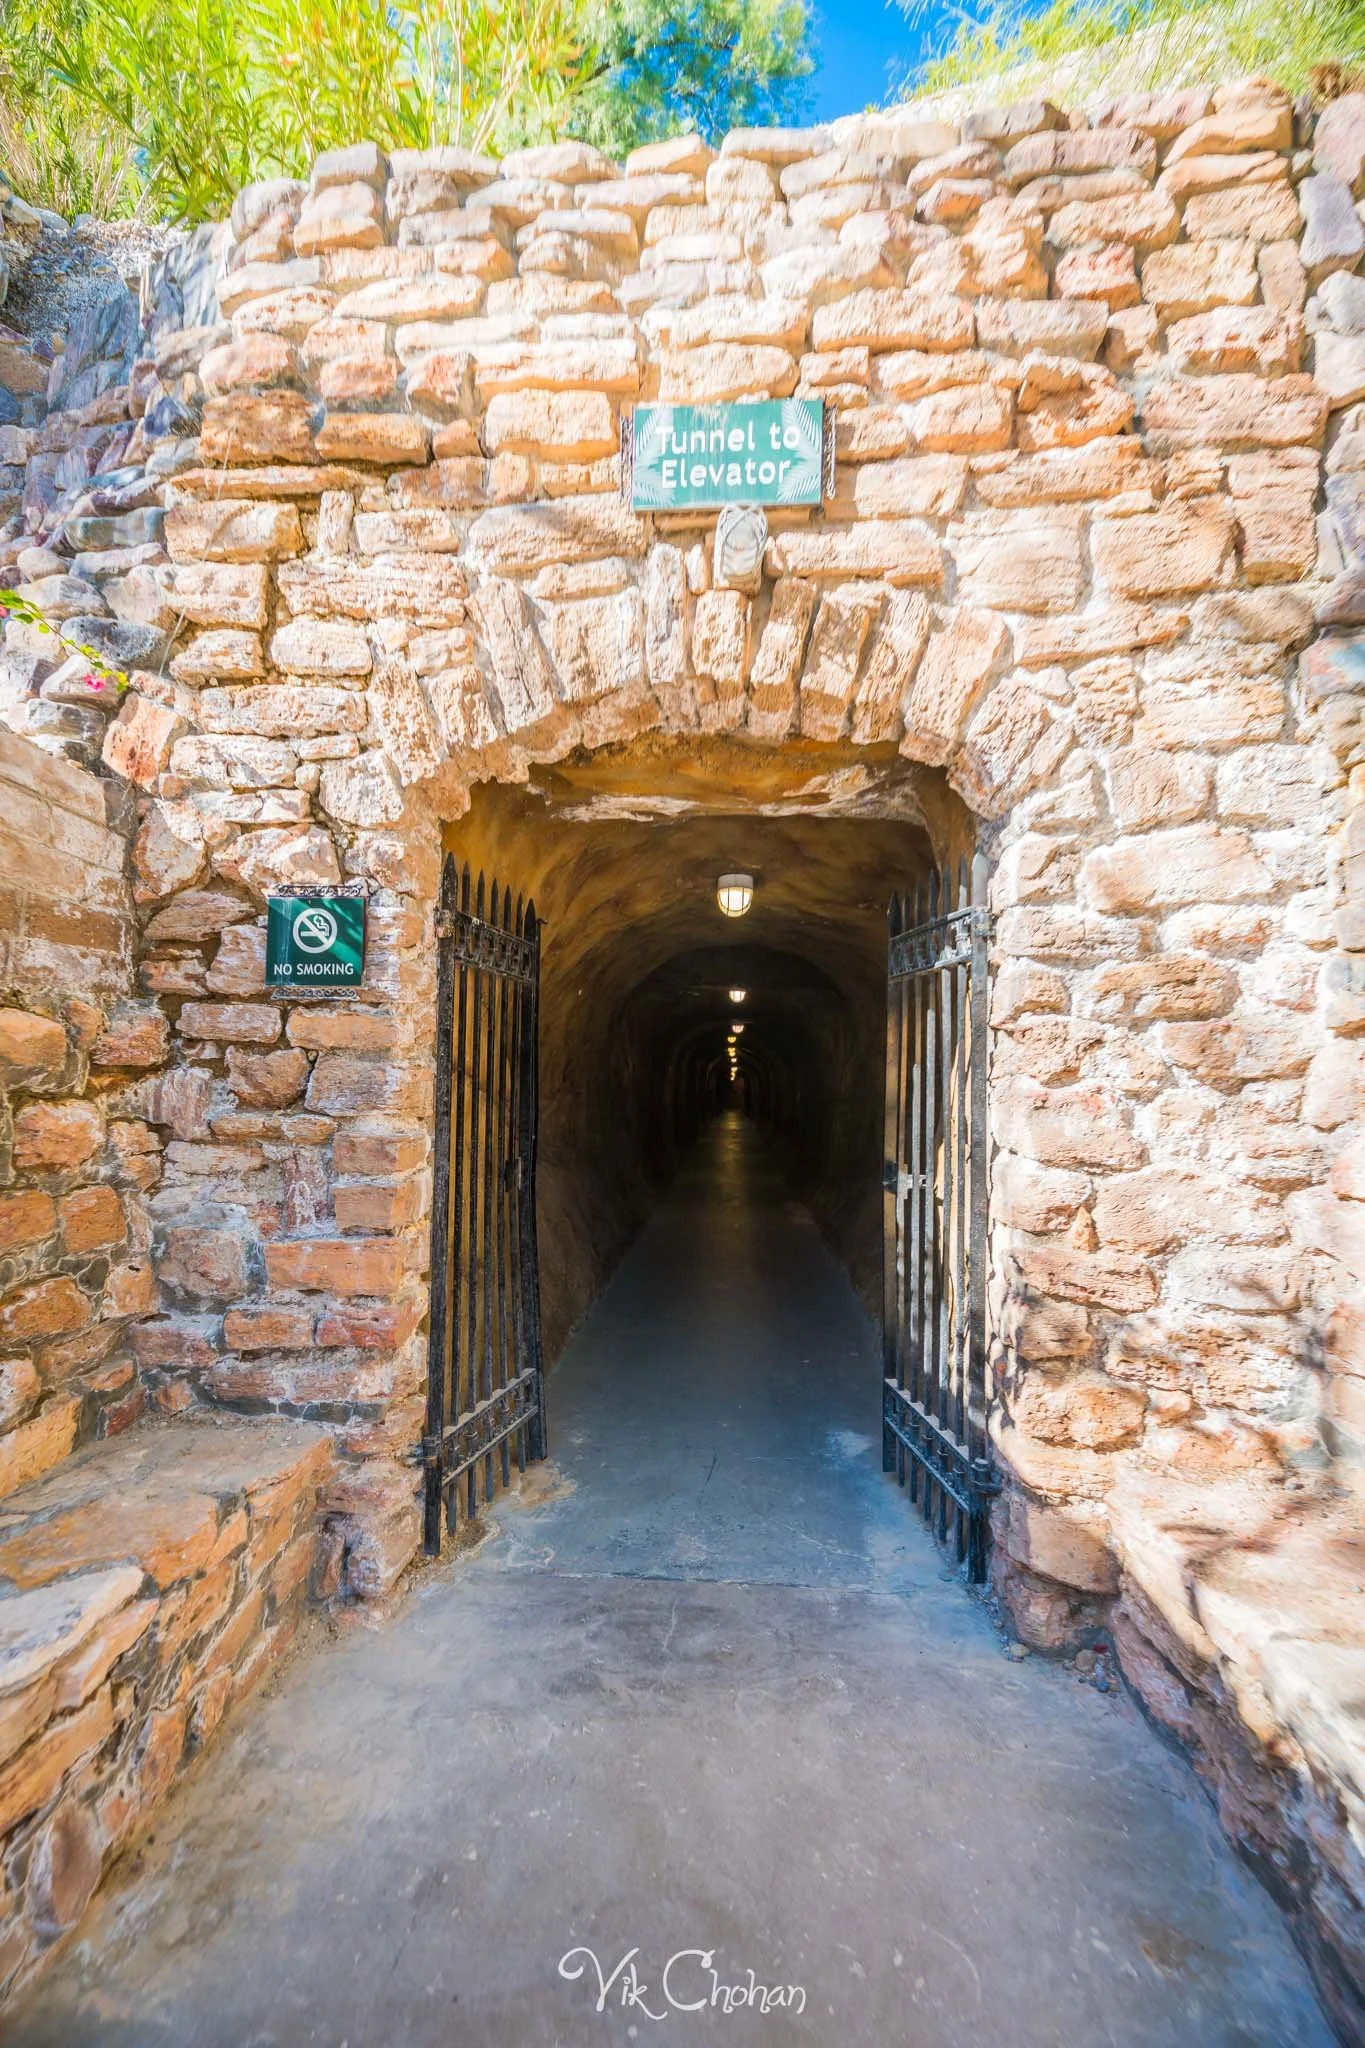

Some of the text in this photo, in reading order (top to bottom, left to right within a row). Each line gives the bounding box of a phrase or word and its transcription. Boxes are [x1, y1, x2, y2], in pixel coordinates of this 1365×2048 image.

[655, 421, 800, 454] Tunnel to
[662, 458, 792, 489] Elevator
[274, 963, 354, 975] NO SMOKING
